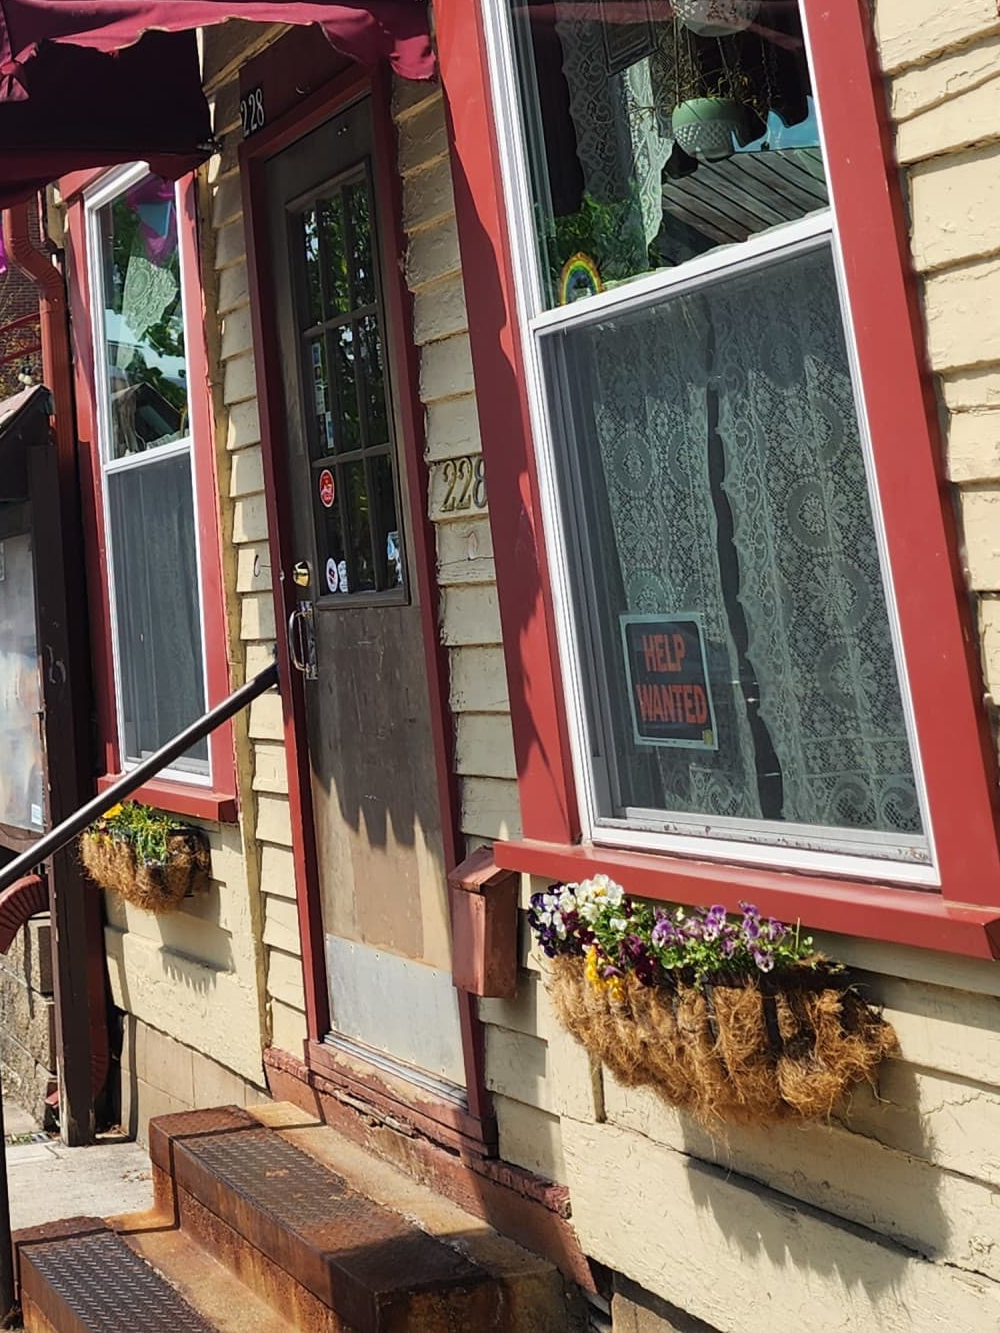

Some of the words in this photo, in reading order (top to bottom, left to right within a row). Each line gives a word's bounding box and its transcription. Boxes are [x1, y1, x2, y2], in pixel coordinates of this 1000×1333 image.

[240, 87, 265, 138] 228
[440, 456, 487, 513] 228
[641, 633, 686, 673] HELP
[634, 683, 709, 725] WANTED
